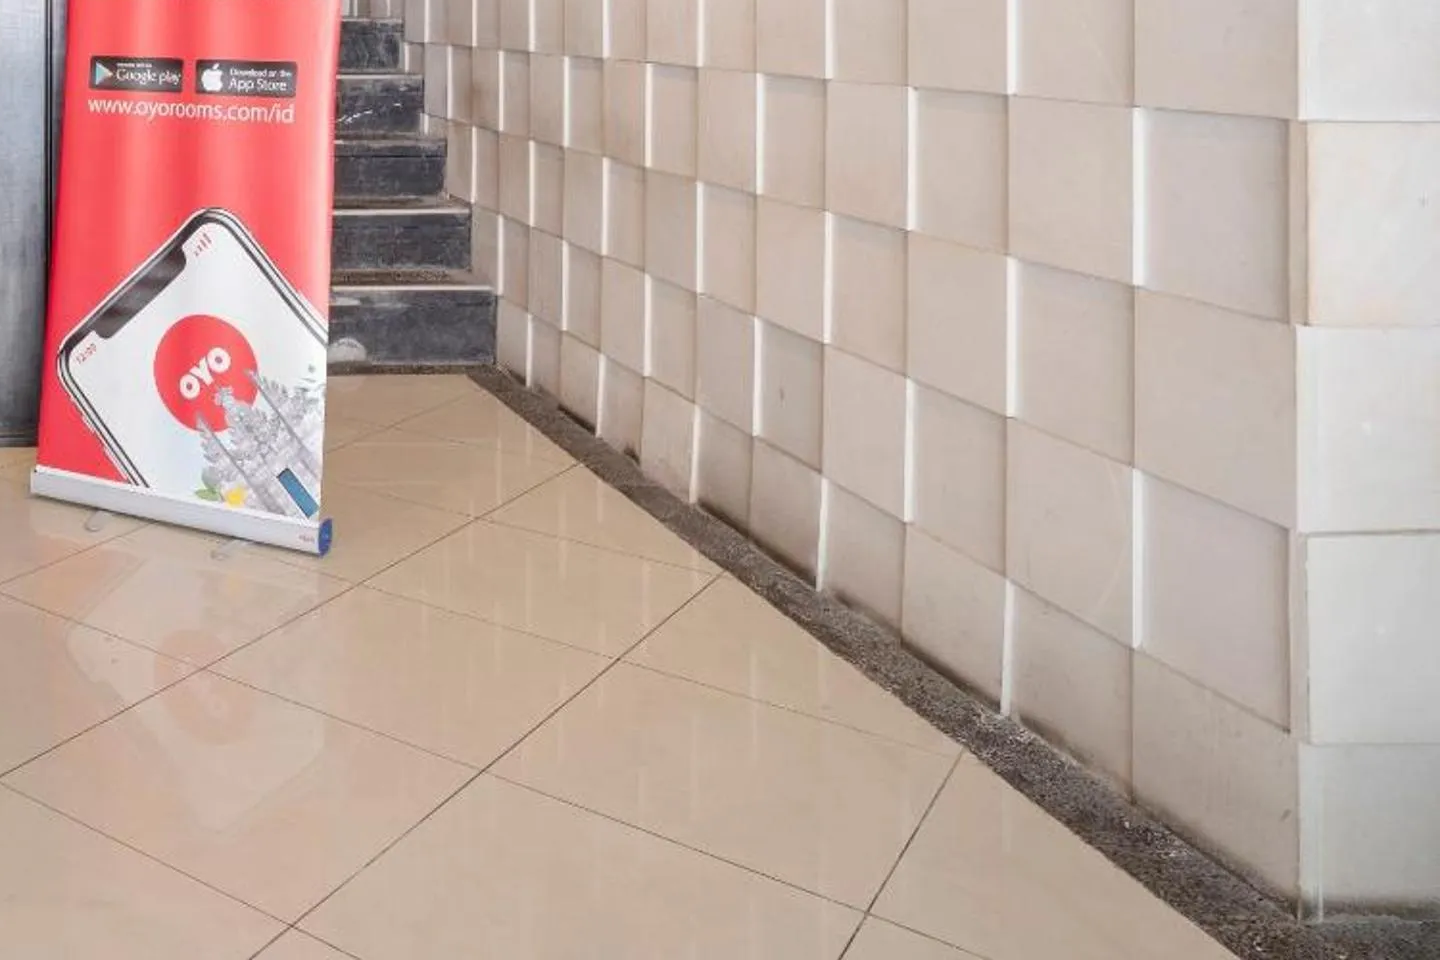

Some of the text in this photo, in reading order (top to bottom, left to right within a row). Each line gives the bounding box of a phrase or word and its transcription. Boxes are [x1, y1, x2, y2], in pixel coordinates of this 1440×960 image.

[115, 68, 158, 86] Google
[228, 77, 287, 92] App Store
[179, 347, 232, 399] OYO
